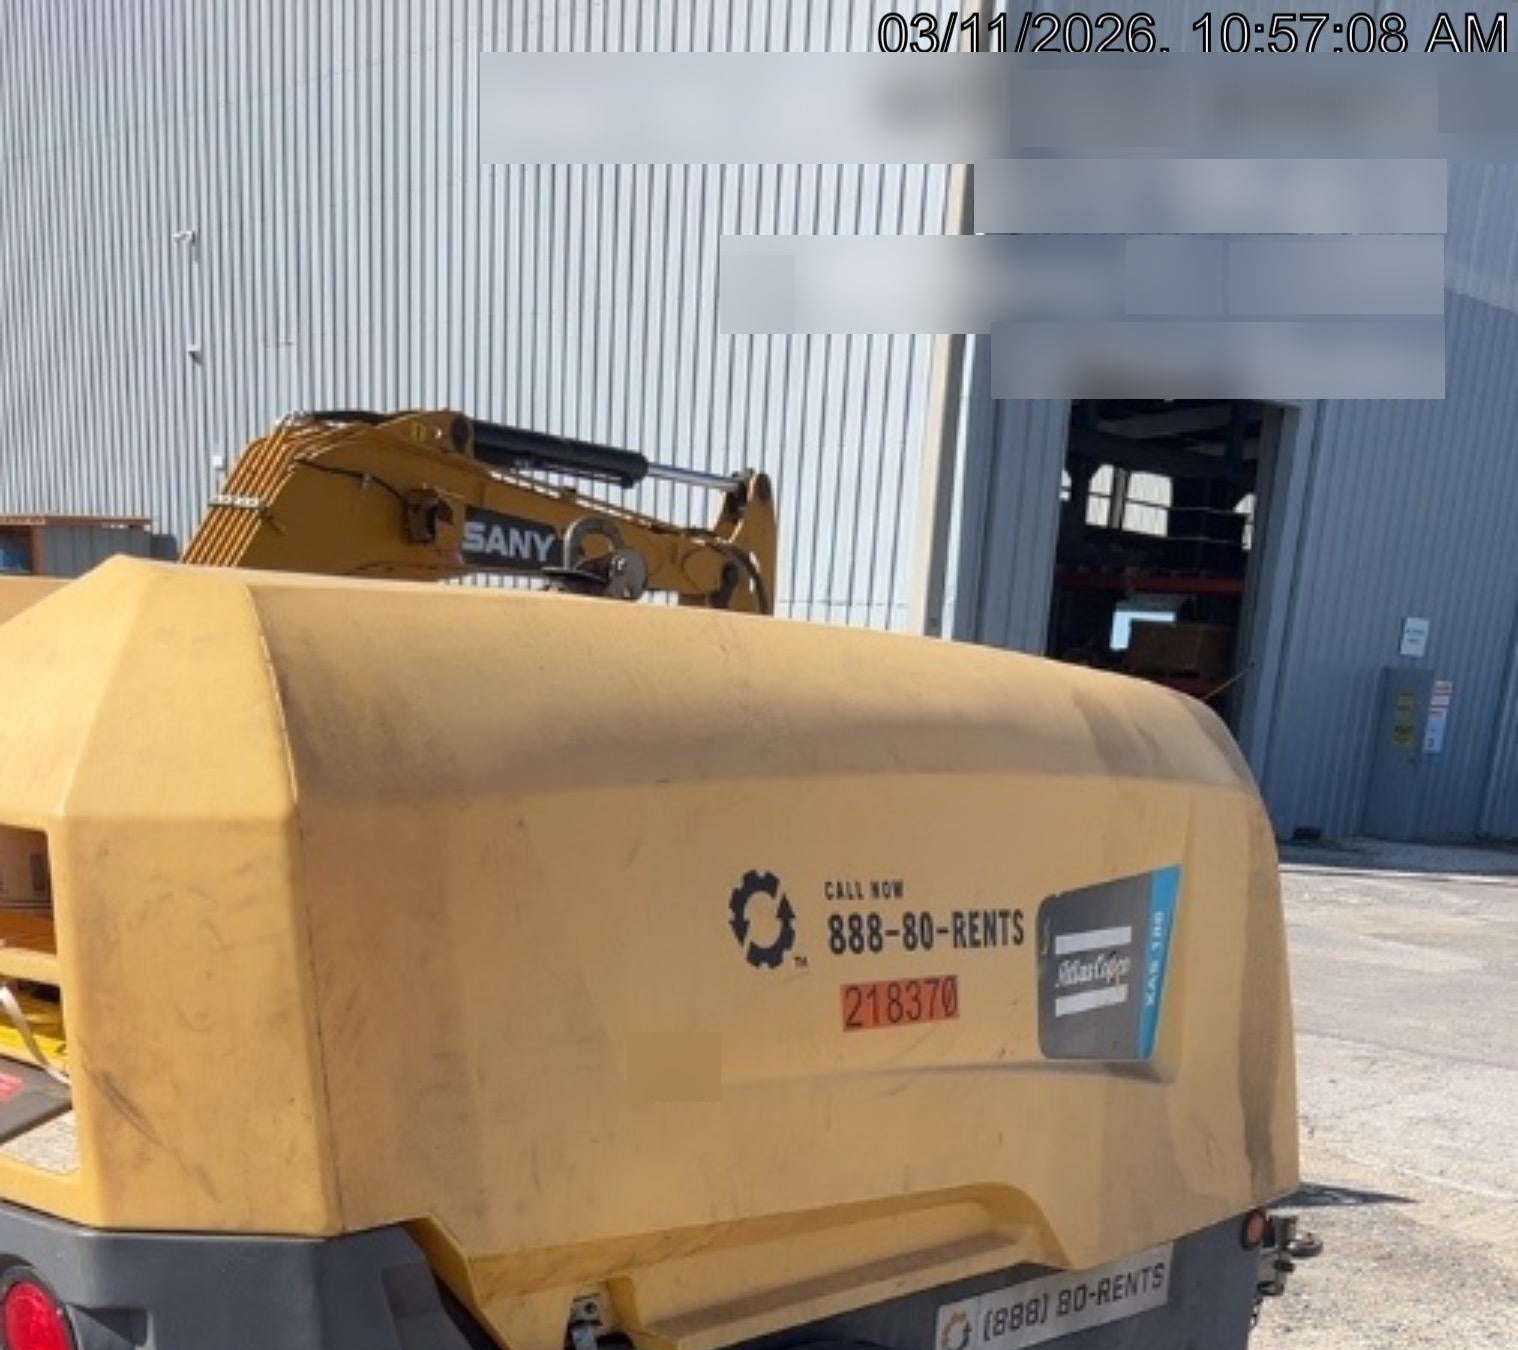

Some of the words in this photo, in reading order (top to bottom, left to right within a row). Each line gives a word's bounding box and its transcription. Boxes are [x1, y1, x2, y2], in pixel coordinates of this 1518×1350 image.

[462, 521, 556, 562] SANY
[824, 880, 864, 900] CALL
[870, 880, 904, 899] NOW
[827, 908, 1025, 955] 888-80-RENTS
[844, 976, 958, 1029] 218370
[983, 1292, 1048, 1342] (888)
[1055, 1262, 1166, 1318] 80-RENTS
